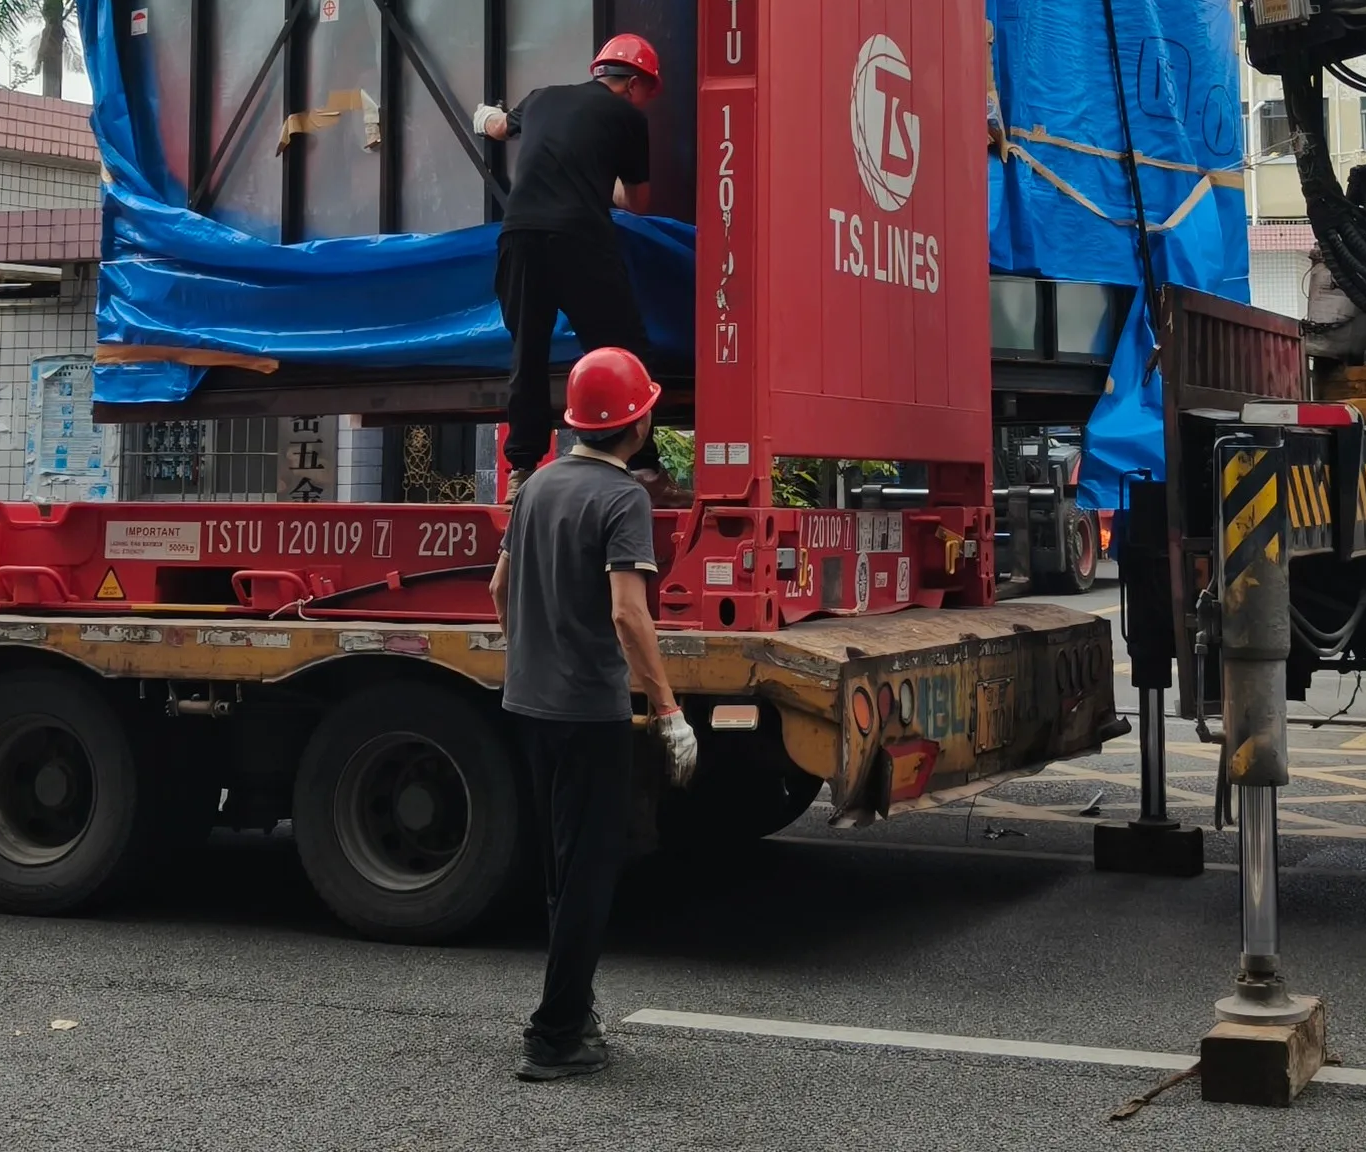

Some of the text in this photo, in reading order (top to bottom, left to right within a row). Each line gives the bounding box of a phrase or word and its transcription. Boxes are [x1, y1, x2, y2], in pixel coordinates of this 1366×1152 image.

[829, 207, 939, 293] T.S. LINES
[125, 526, 181, 537] IMPORTANT
[206, 520, 478, 556] TSTU 120109 7 22P3
[807, 515, 842, 548] 120109
